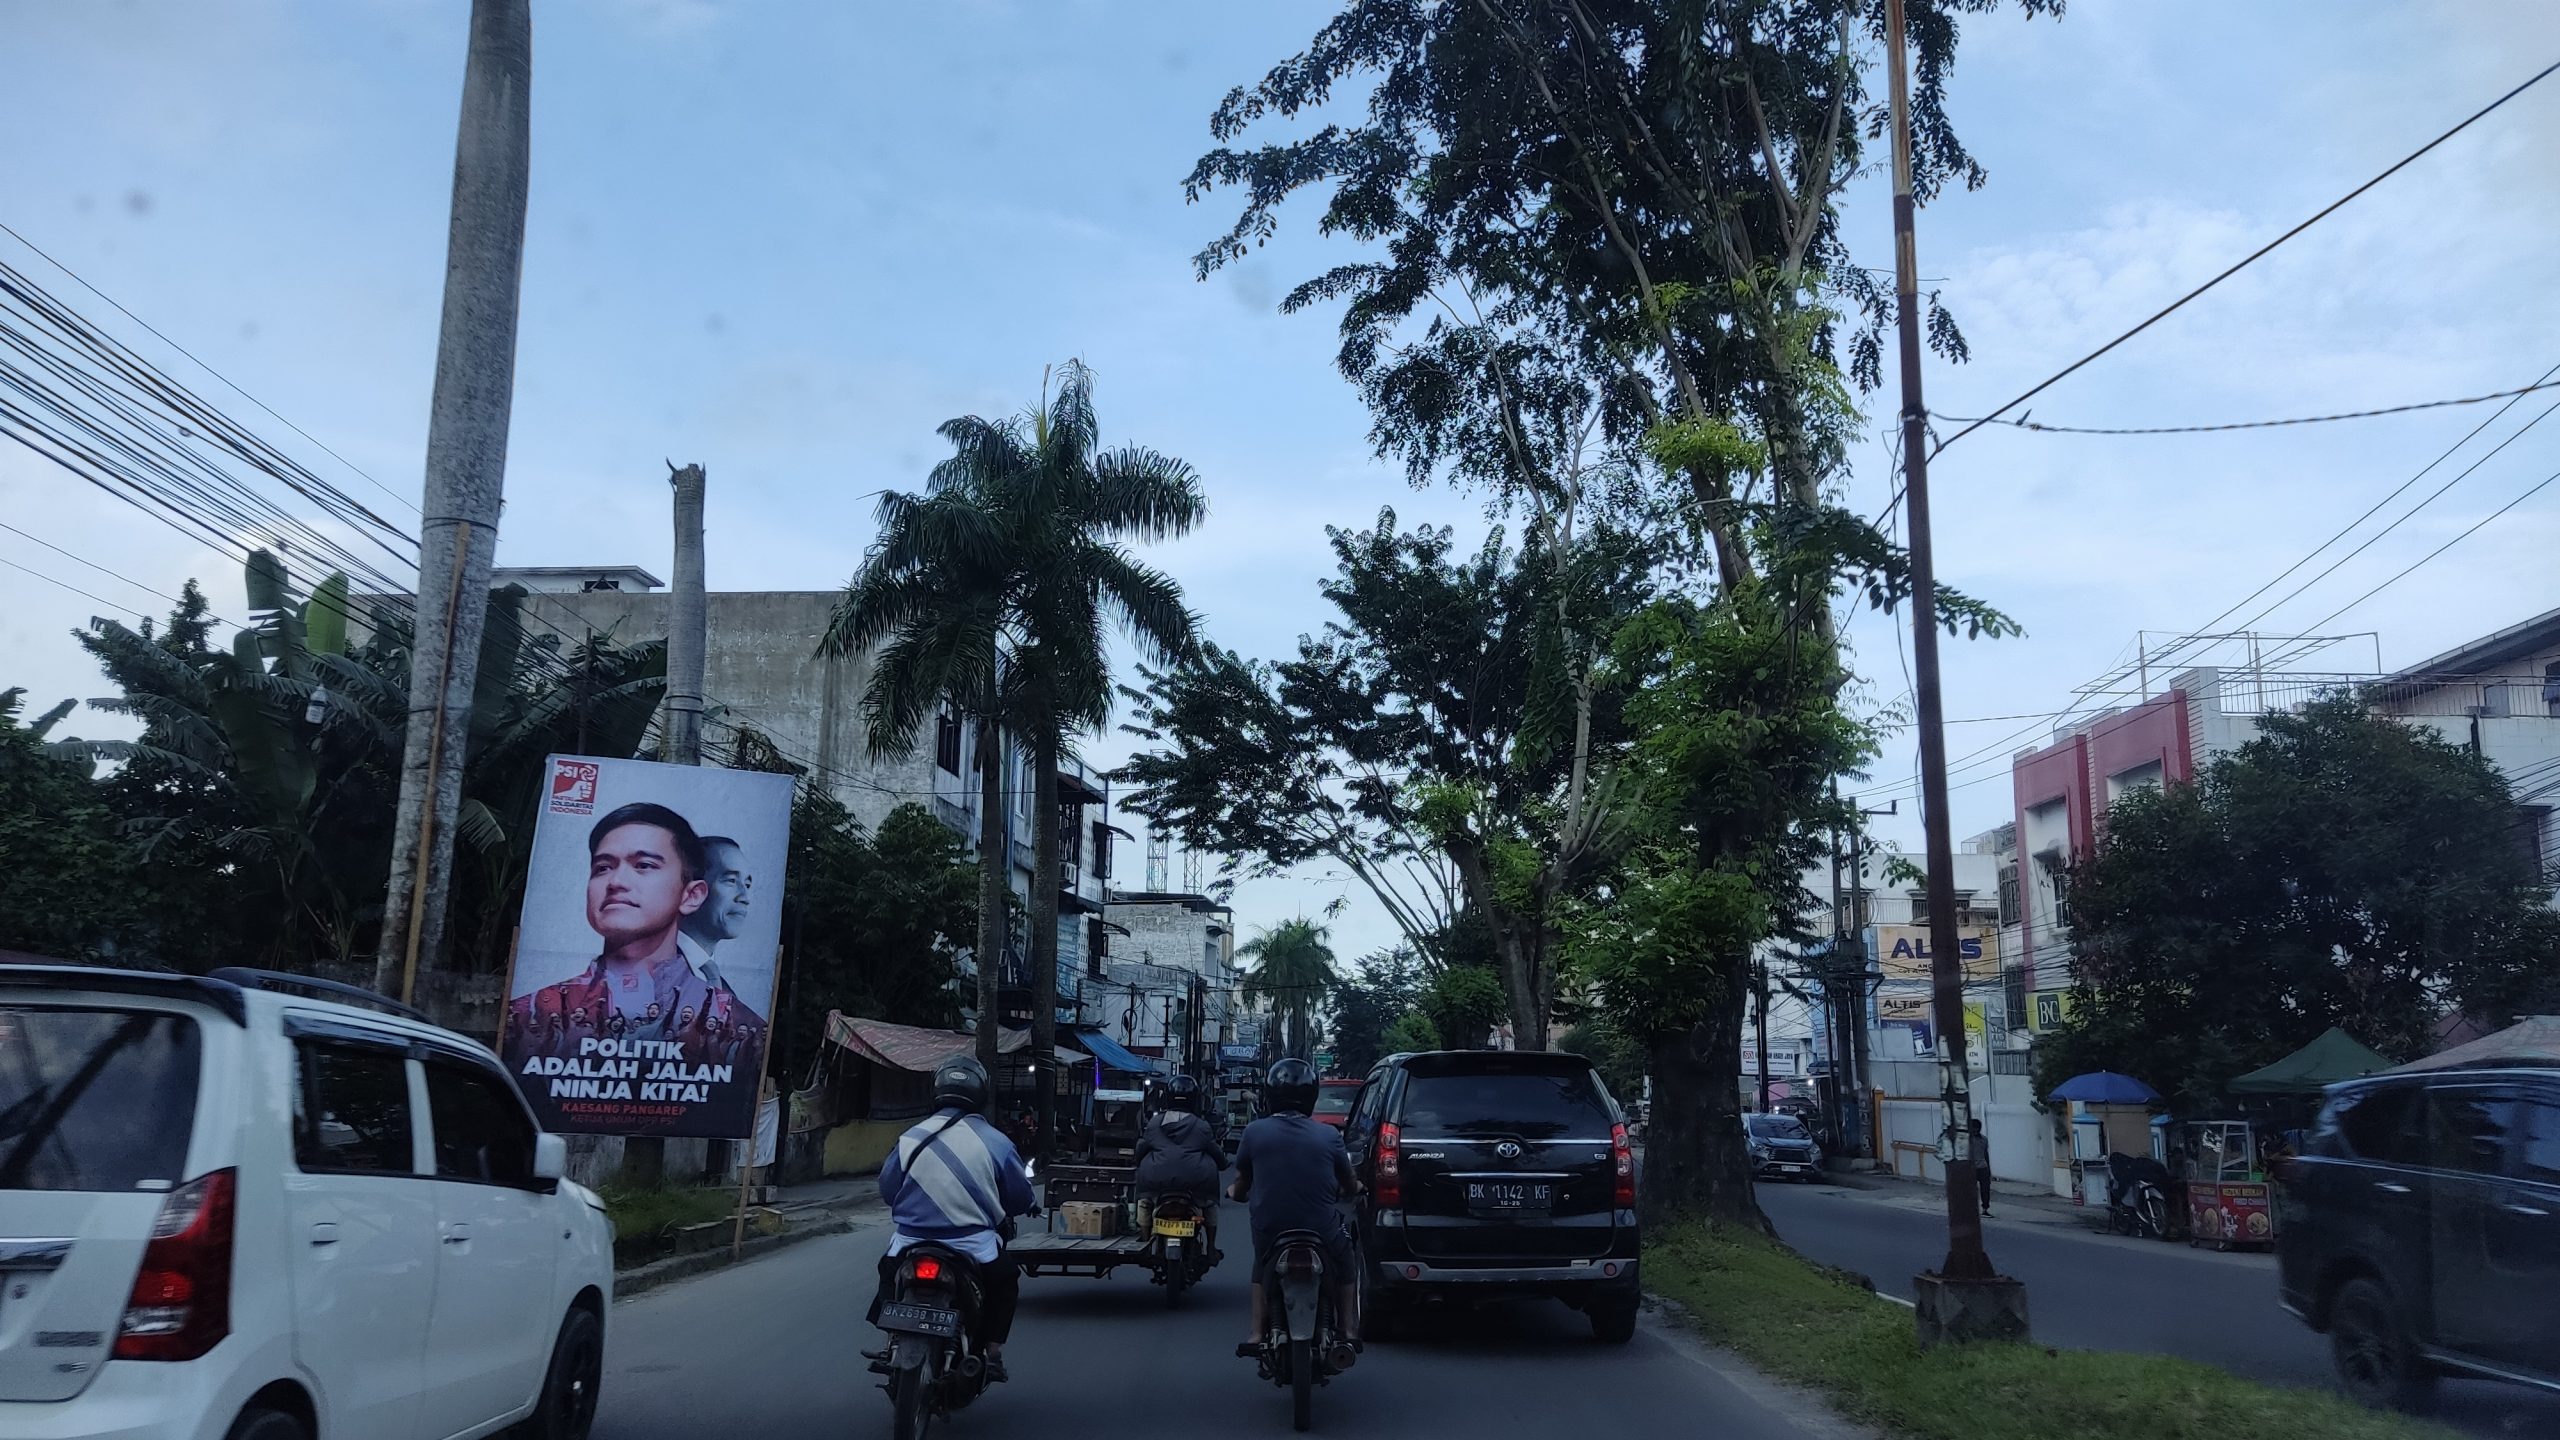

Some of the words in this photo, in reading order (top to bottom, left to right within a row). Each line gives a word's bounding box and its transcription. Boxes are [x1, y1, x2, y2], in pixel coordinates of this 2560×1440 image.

[555, 766, 578, 778] PSI
[550, 801, 594, 809] SOLIDARITAS
[550, 807, 593, 815] INDONESIA
[1891, 938, 1982, 959] ALS
[1883, 1000, 1921, 1010] ALTIS
[579, 1037, 686, 1060] POLITIK
[521, 1056, 640, 1079] ADALAH
[644, 1061, 733, 1083] JALAN
[550, 1078, 633, 1100] NINJA
[639, 1082, 710, 1103] KITA!
[561, 1102, 620, 1114] KAESANG
[623, 1104, 687, 1116] PANGAREP
[1470, 1184, 1484, 1199] BK
[1495, 1185, 1524, 1199] 1142
[1534, 1185, 1550, 1199] KF
